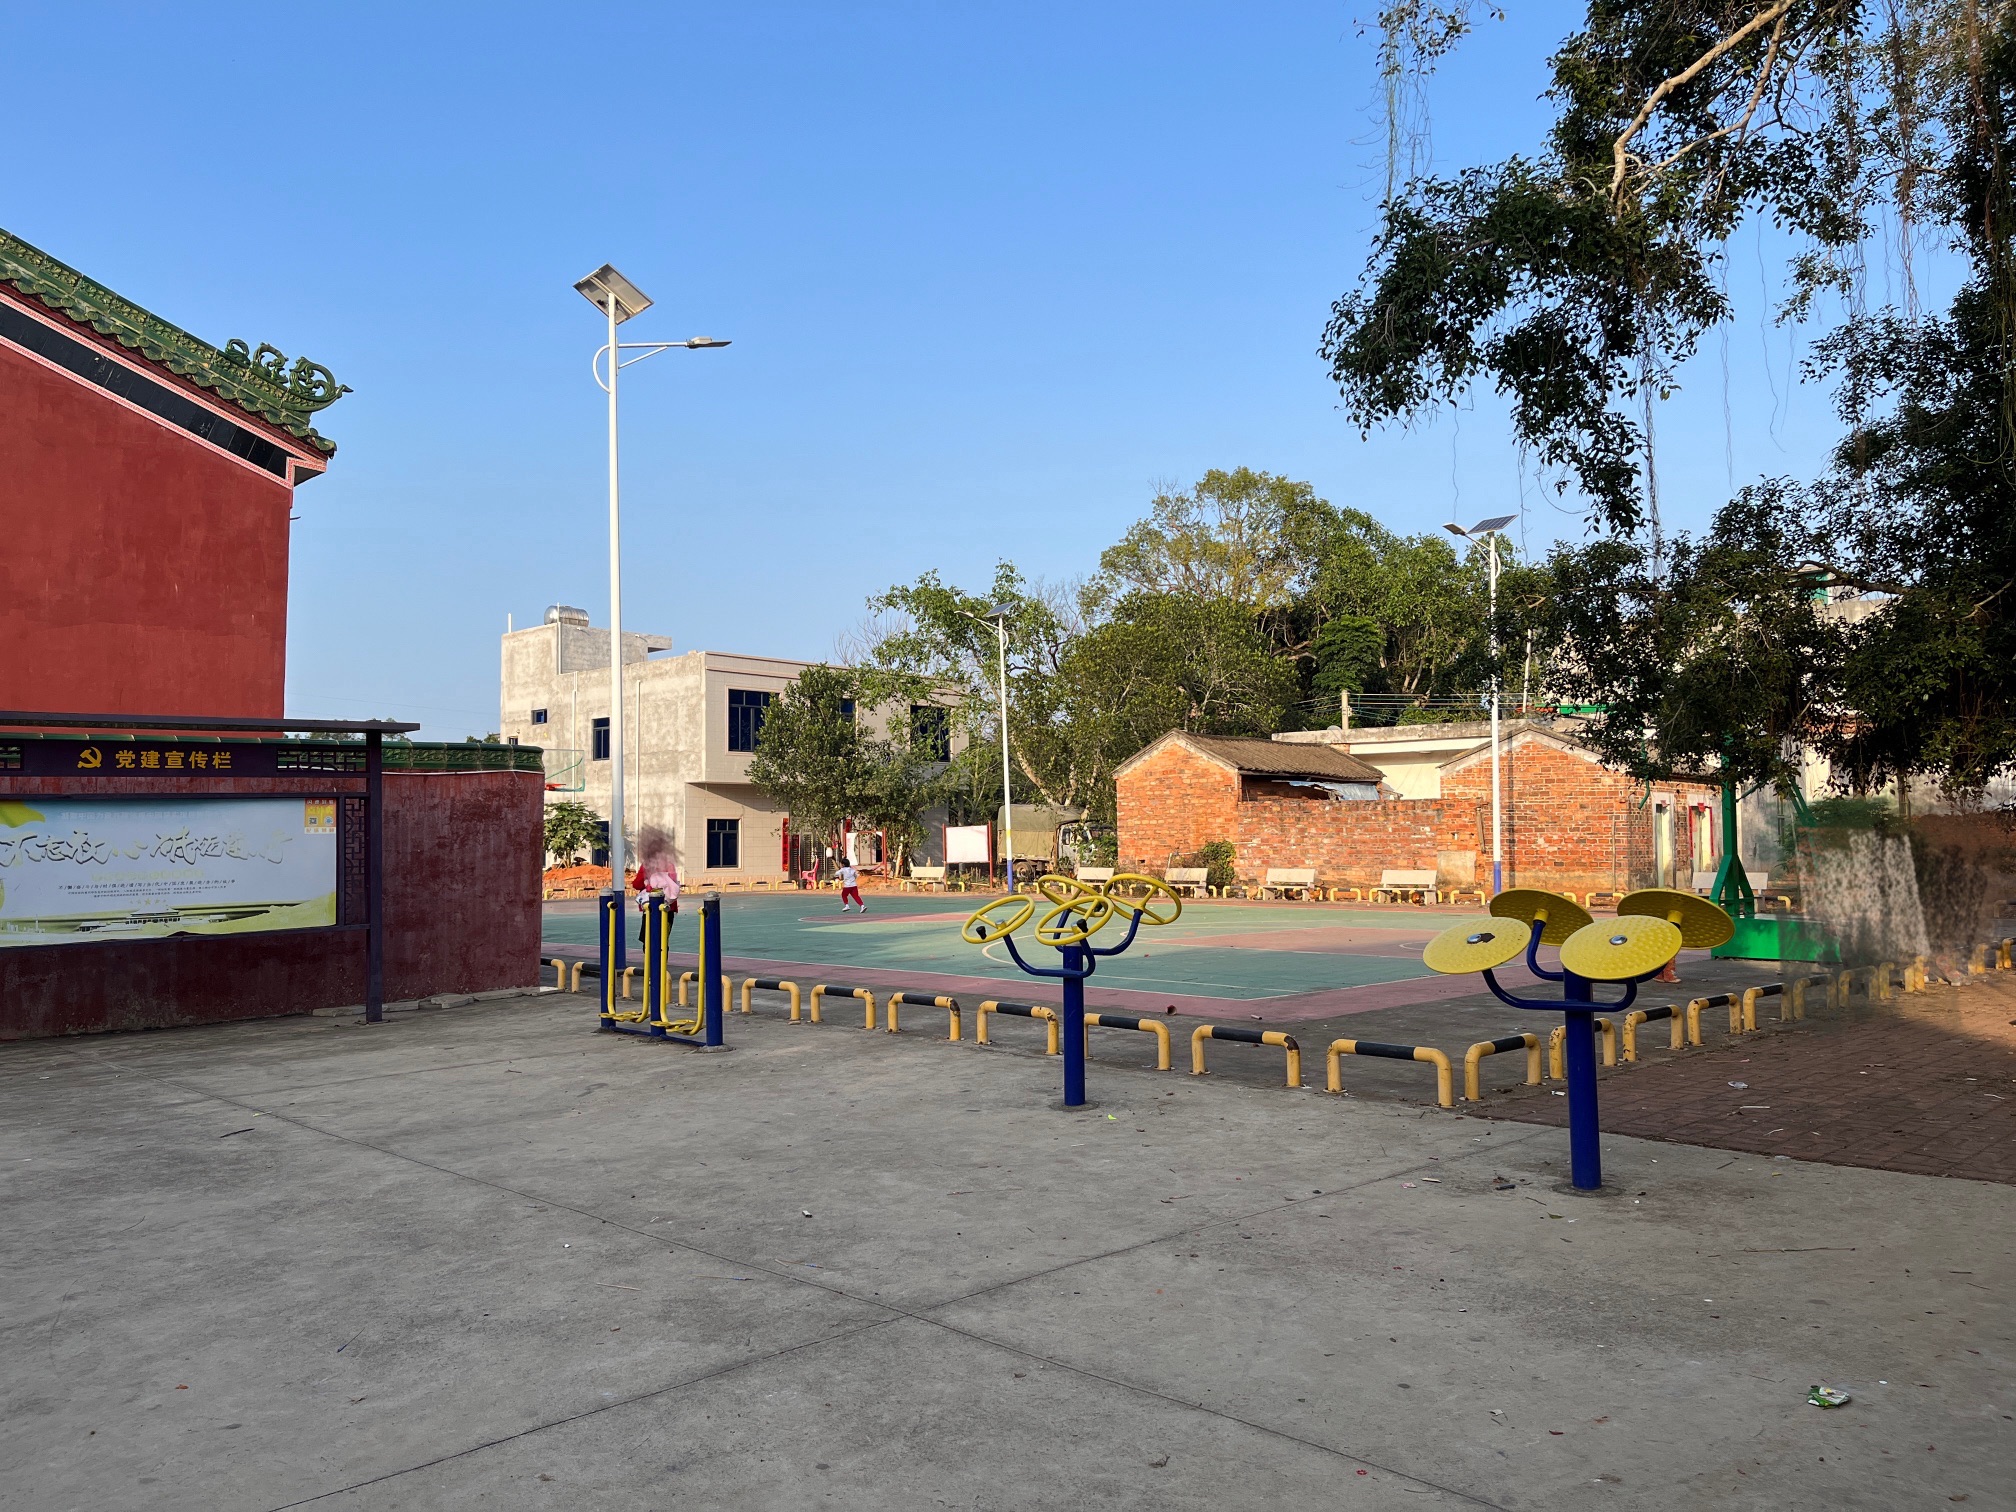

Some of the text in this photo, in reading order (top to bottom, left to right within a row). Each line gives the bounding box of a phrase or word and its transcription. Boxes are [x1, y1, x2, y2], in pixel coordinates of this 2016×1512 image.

[115, 750, 232, 769] 党建宣传栏
